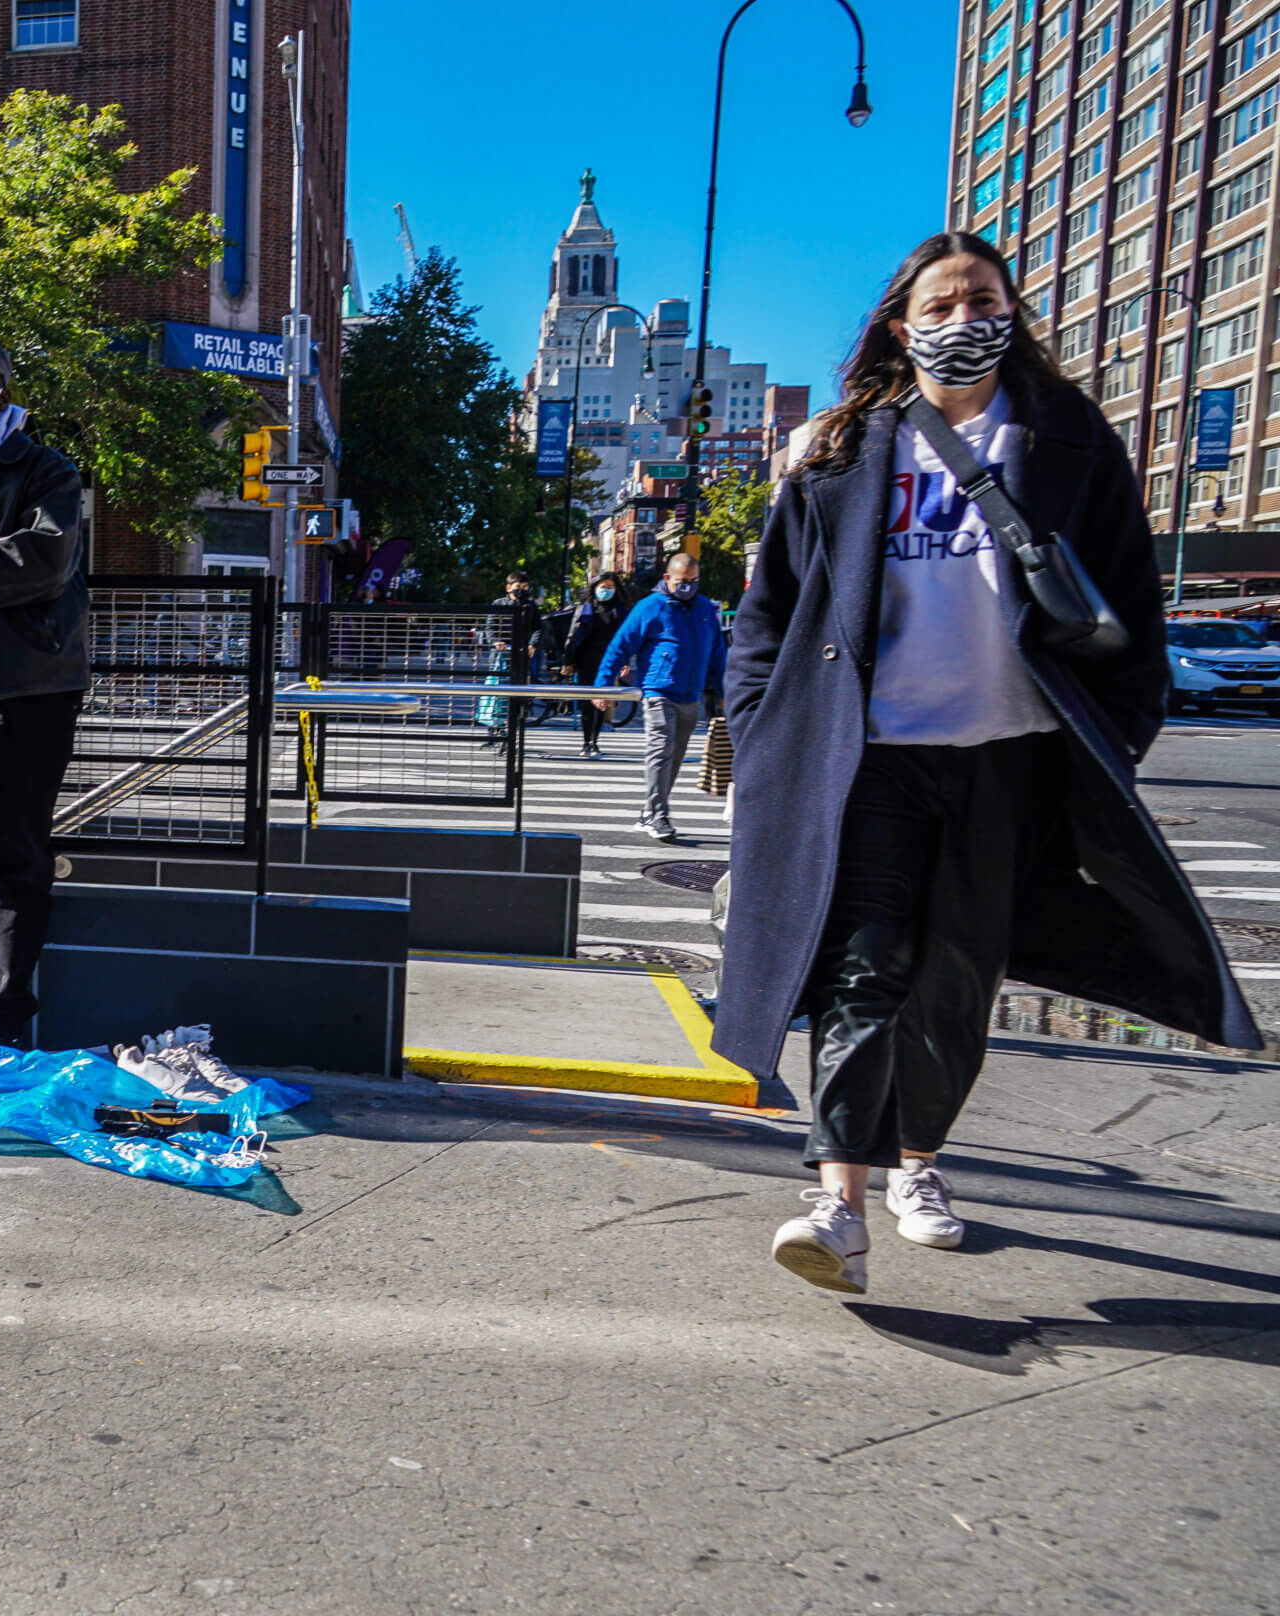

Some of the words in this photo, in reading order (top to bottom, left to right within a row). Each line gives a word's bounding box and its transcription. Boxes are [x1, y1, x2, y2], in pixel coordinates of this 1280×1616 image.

[231, 0, 247, 149] ENUE
[194, 334, 244, 355] RETAIL
[205, 352, 284, 375] AVAILABLE
[271, 471, 289, 480] ONE
[296, 471, 315, 480] WAY
[884, 526, 995, 561] ALTHCA
